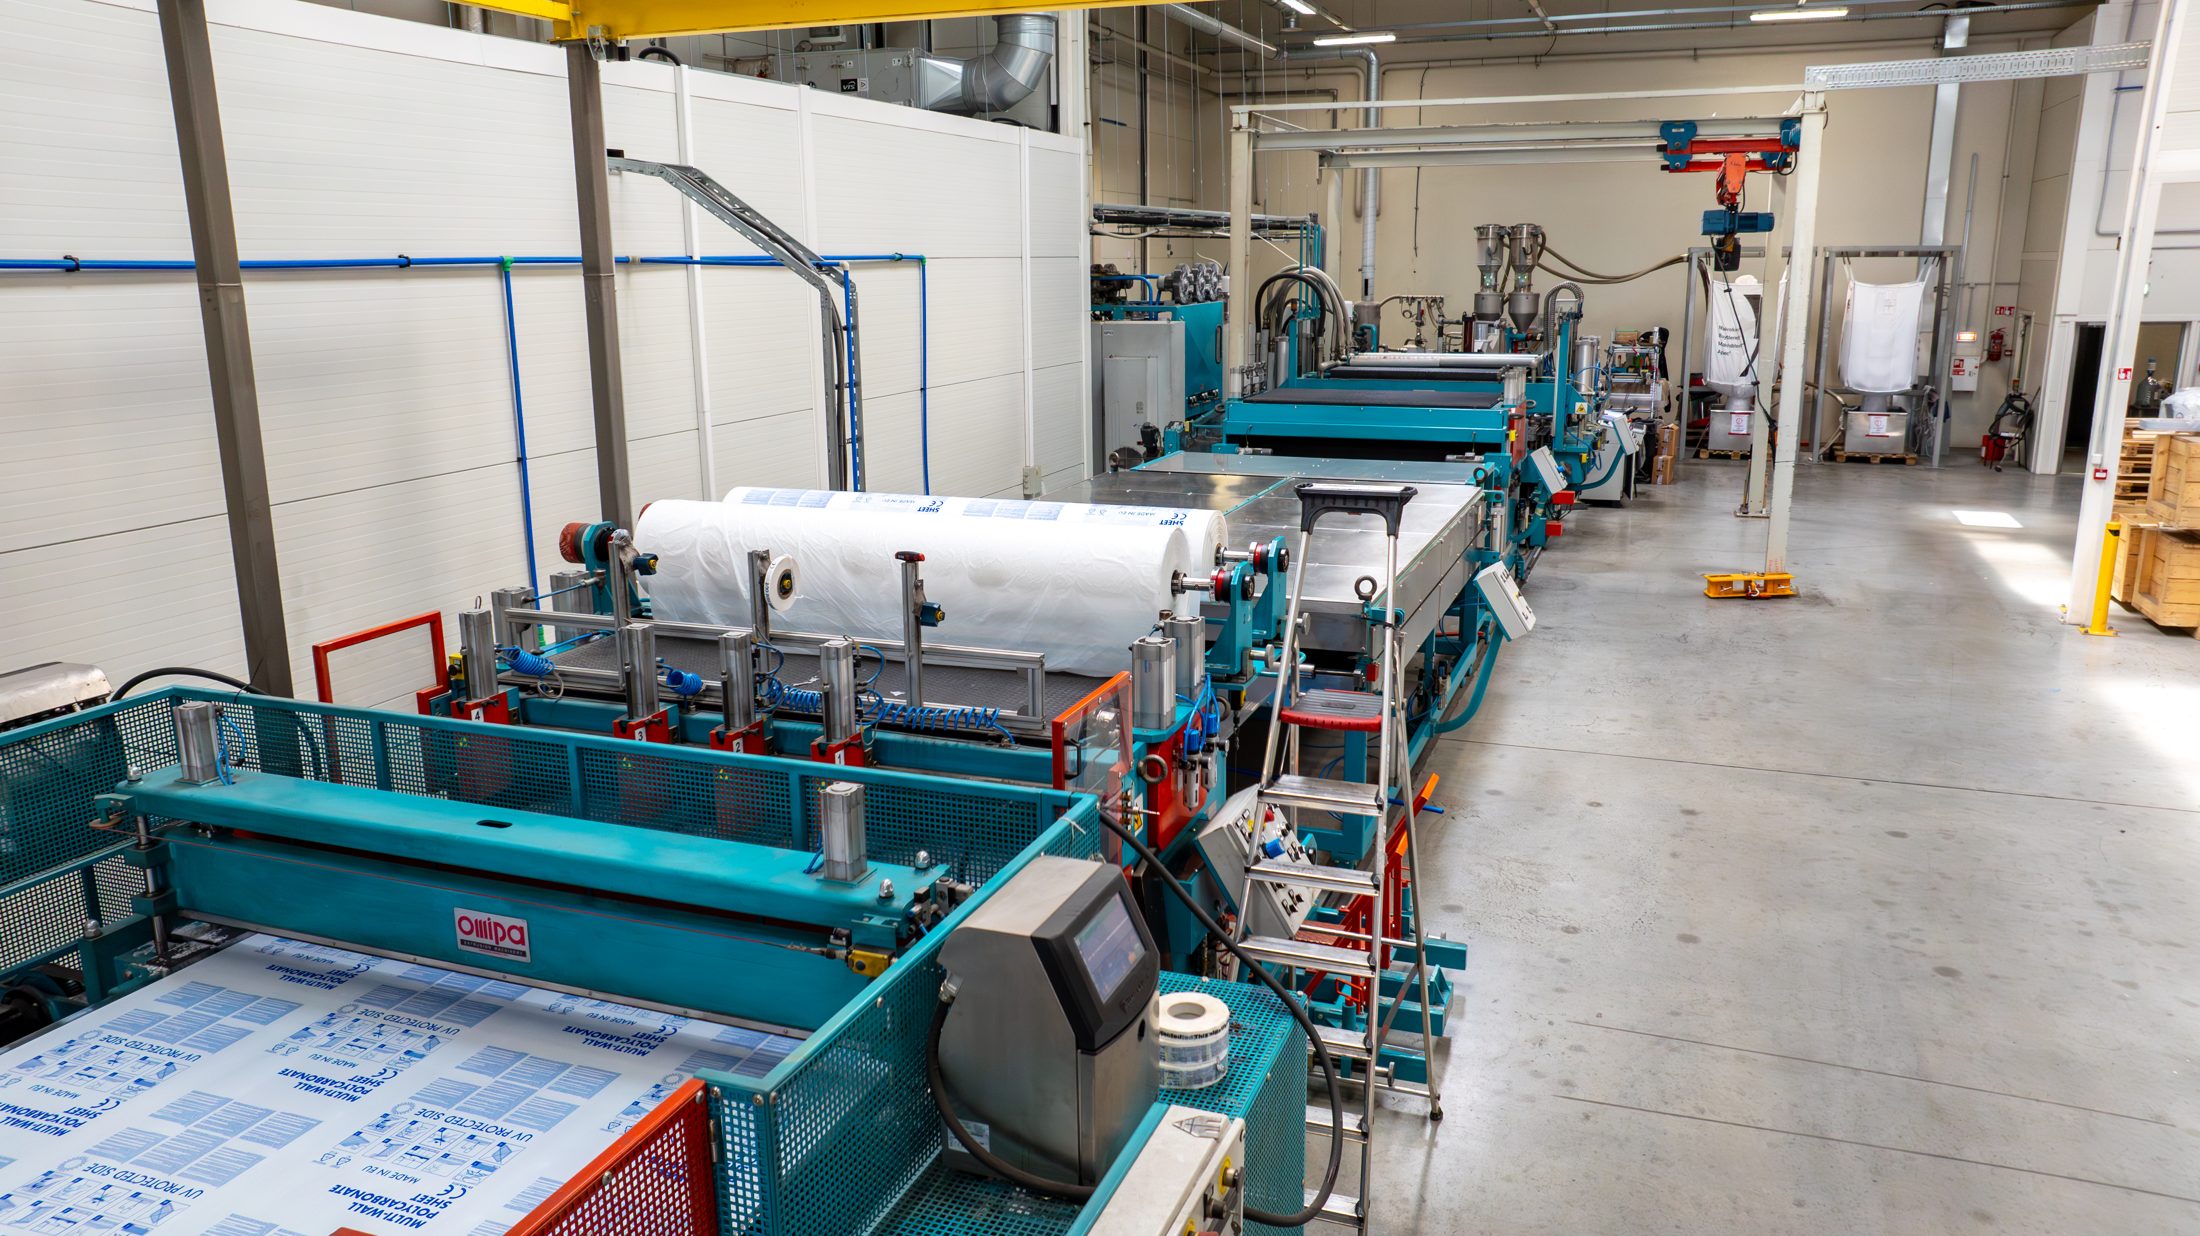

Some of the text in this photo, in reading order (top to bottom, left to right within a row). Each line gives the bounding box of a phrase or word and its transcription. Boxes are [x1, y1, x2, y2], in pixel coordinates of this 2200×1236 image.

[638, 731, 644, 741] 3
[735, 741, 741, 752] 2
[265, 964, 348, 984] POLYCARBONATE
[280, 974, 338, 990] MULTI-WALL
[326, 969, 358, 978] SHEET
[357, 1009, 460, 1035] UV PROTECTED SIDE
[562, 1026, 659, 1050] POLYCARBONATE
[632, 1031, 667, 1043] SHEET
[100, 1034, 201, 1062] UV PROTECTED SIDE
[582, 1038, 651, 1057] MULTI-WALL
[332, 1059, 359, 1068] MADE
[277, 1068, 373, 1095] POLYCARBONATE
[348, 1075, 385, 1088] SHEET
[53, 1089, 82, 1100] MADE
[294, 1082, 361, 1102] MULTI-WALL
[0, 1102, 87, 1128] POLYCARBONA
[64, 1106, 103, 1119] SHEET
[0, 1116, 71, 1136] MULTI-WALL
[414, 1108, 534, 1142] UV PROTECTED SIDE
[362, 1165, 378, 1173] EU
[389, 1172, 421, 1184] MADE
[82, 1163, 204, 1200] UV PROTECTED SIDE
[328, 1184, 440, 1219] POLYCARBONATE
[410, 1193, 452, 1209] SHEET
[348, 1201, 427, 1229] MULTI-WALL
